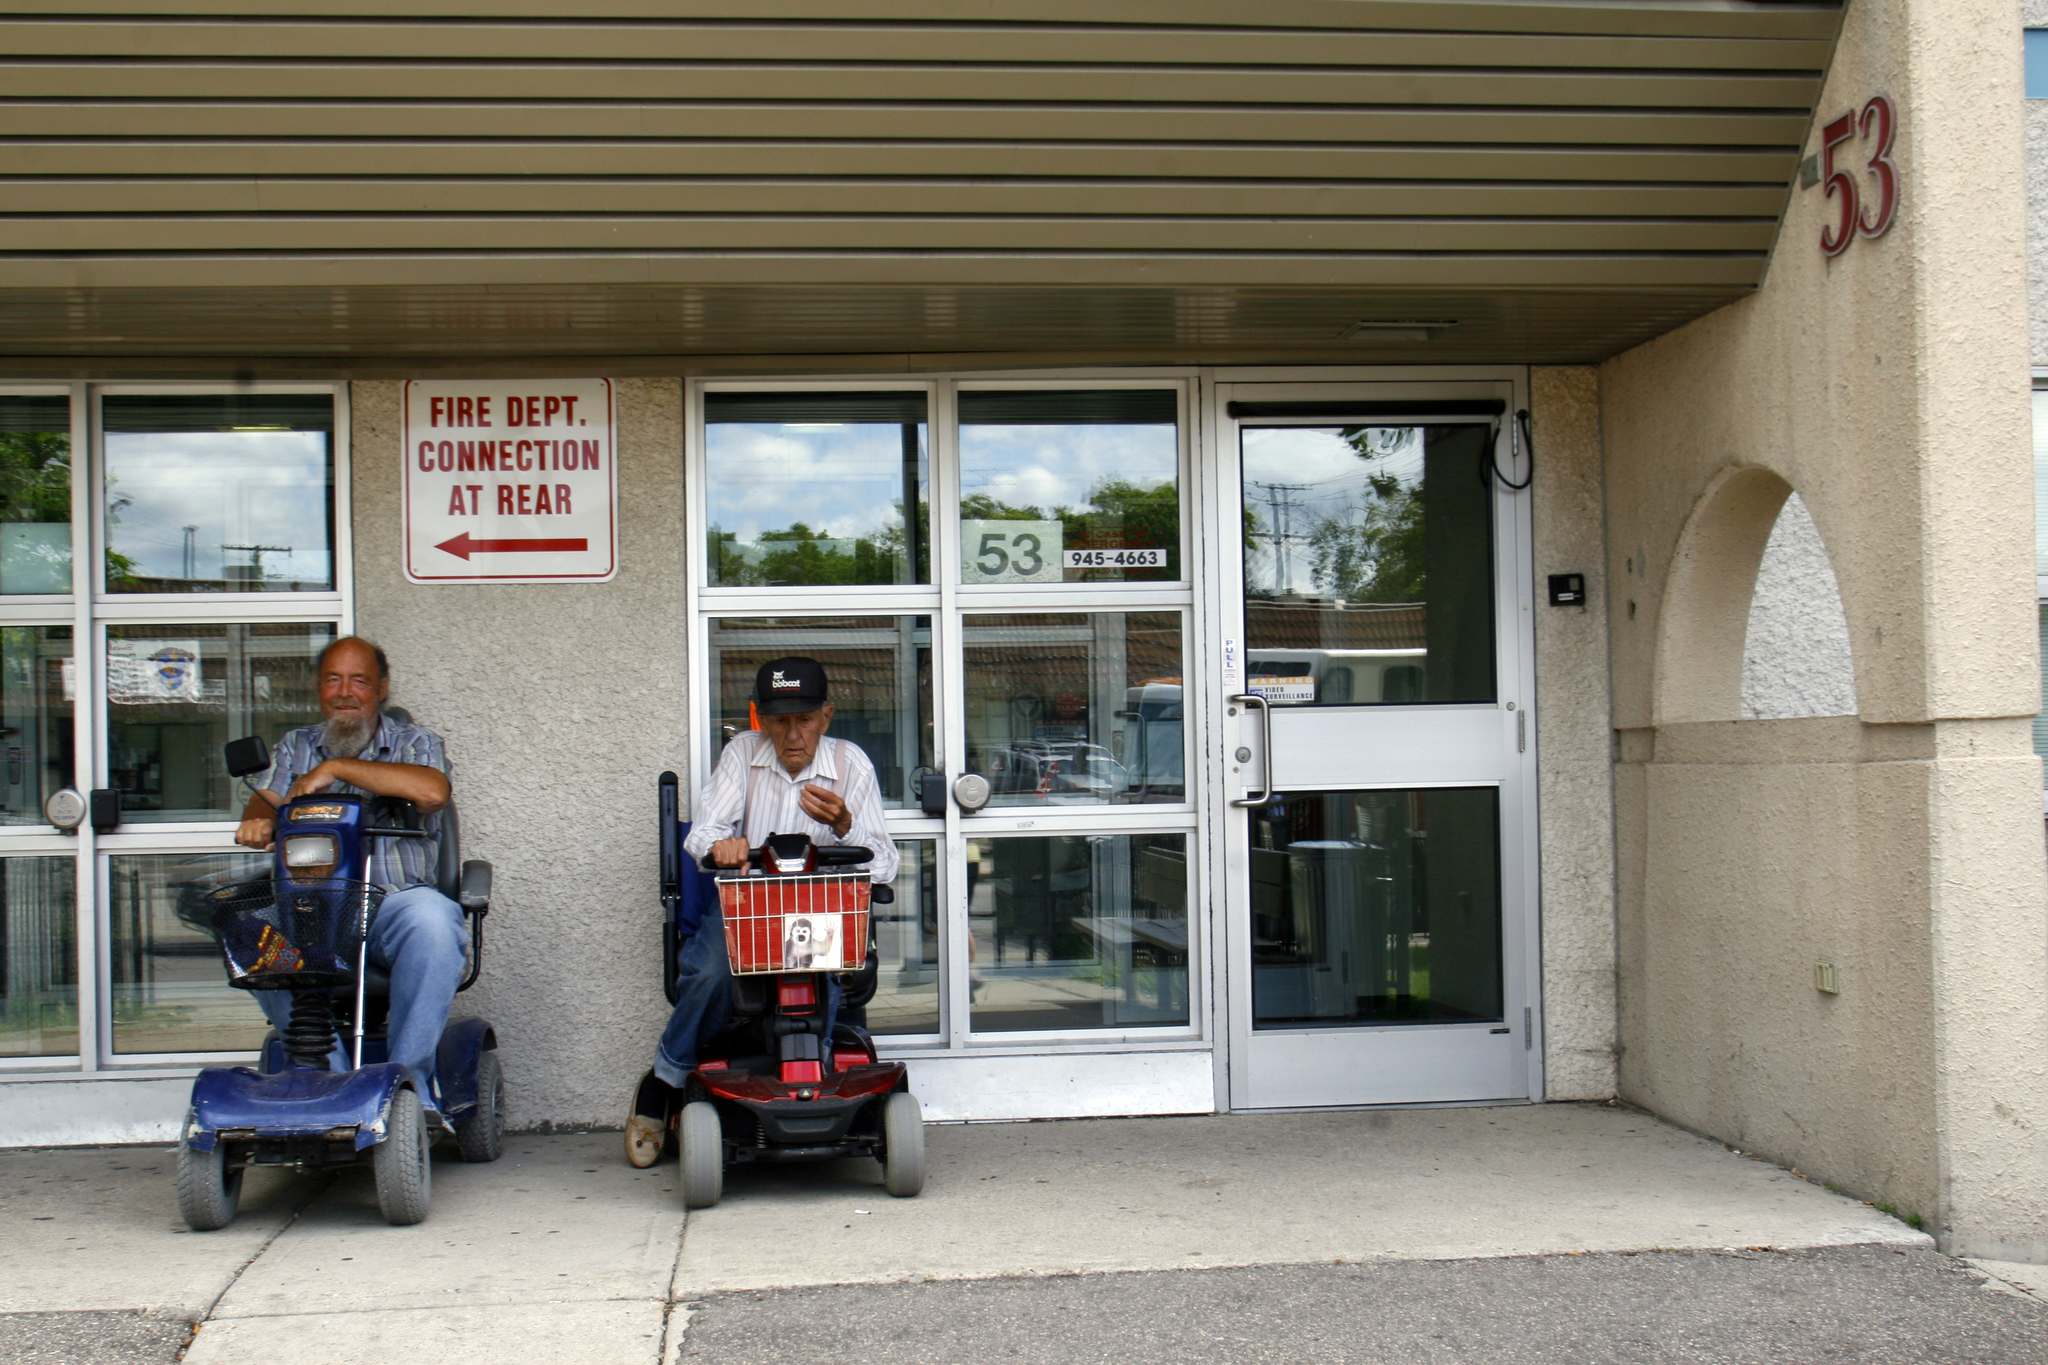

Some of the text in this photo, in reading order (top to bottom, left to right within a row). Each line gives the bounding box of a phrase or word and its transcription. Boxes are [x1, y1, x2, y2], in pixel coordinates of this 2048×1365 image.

[1820, 96, 1899, 257] 53
[430, 395, 587, 428] FIRE DEPT.
[418, 439, 600, 473] CONNECTION
[448, 483, 572, 516] AT REAR
[976, 533, 1043, 576] 53
[1071, 551, 1158, 566] 945-4663
[1225, 640, 1234, 668] PULL
